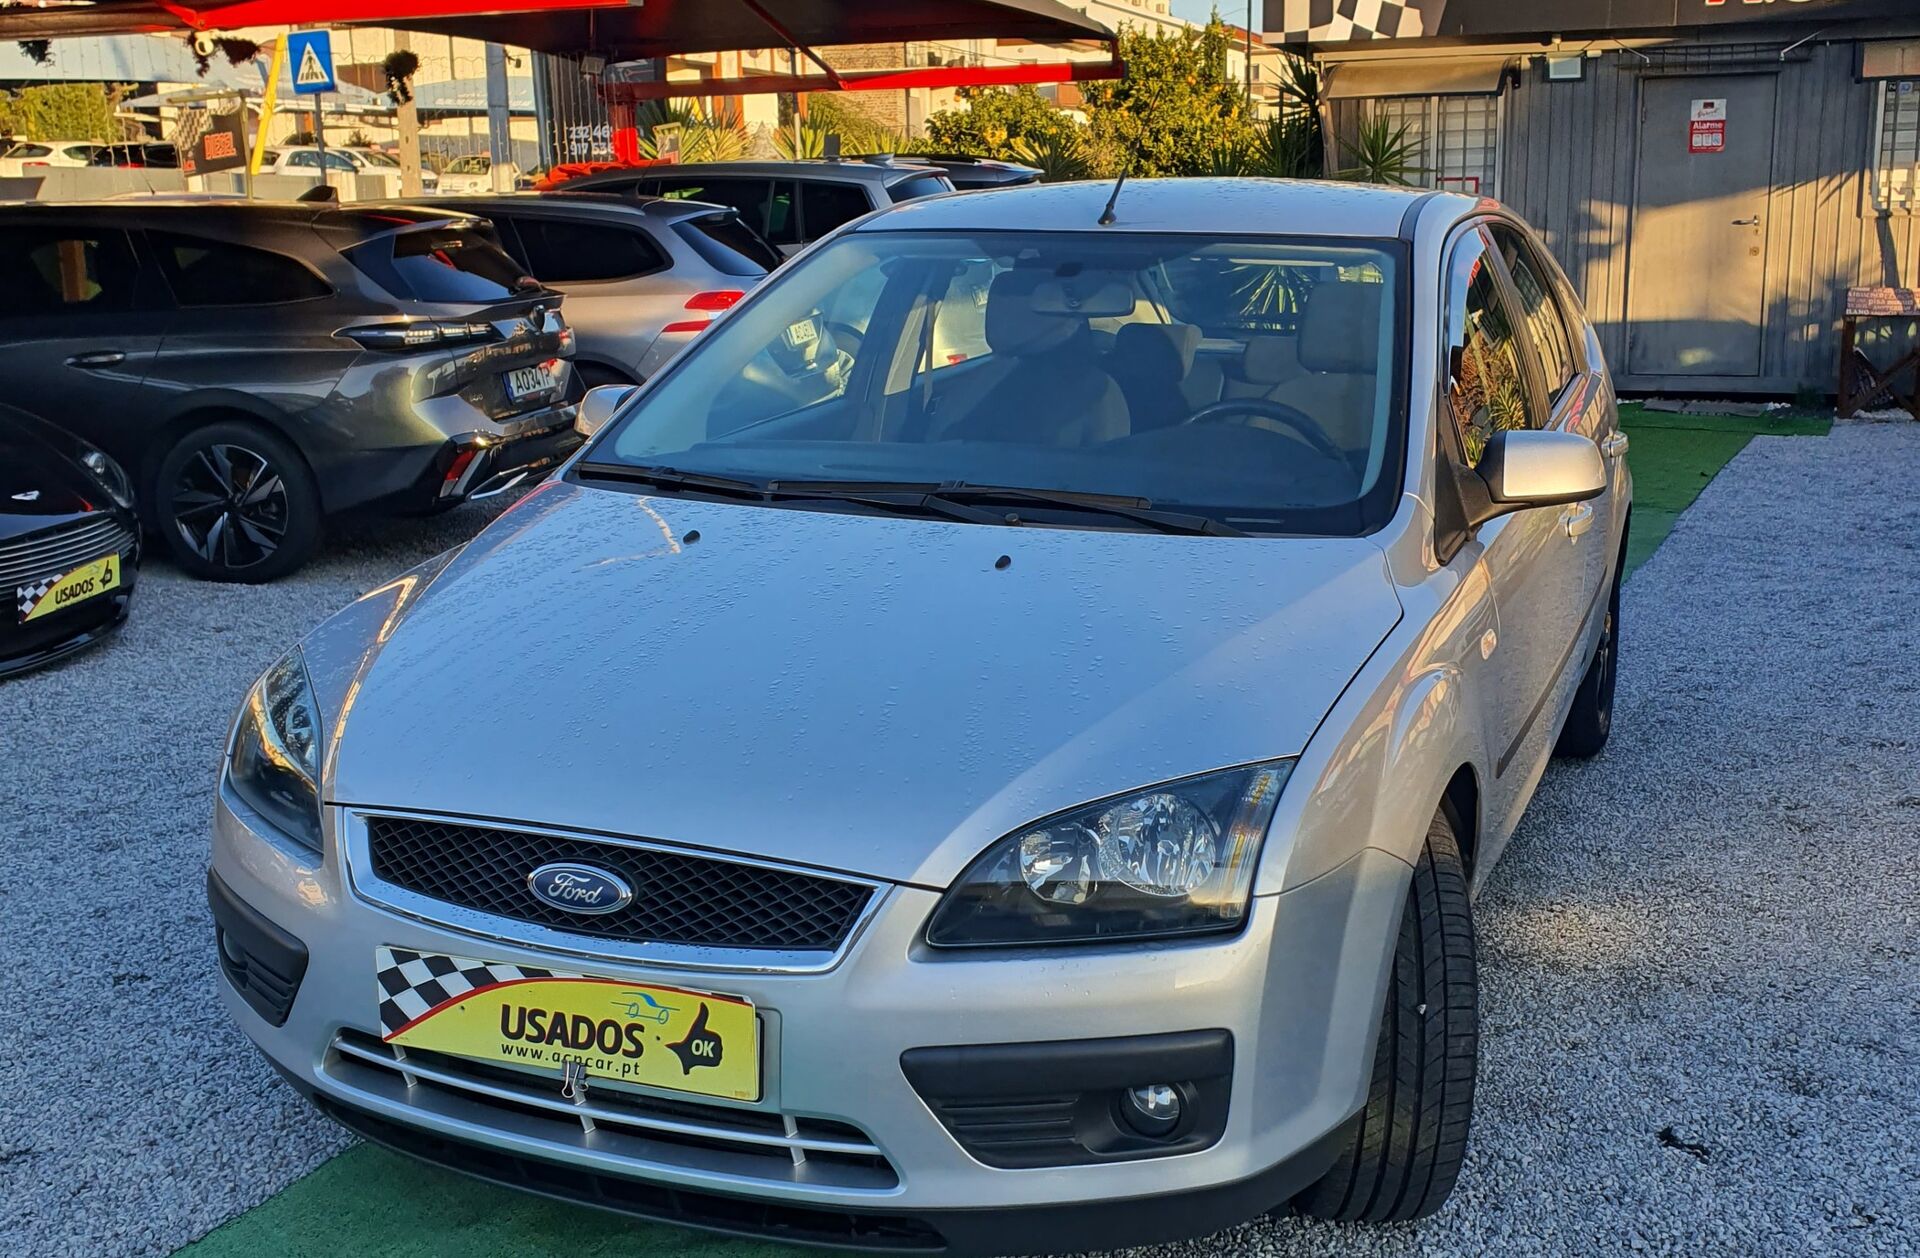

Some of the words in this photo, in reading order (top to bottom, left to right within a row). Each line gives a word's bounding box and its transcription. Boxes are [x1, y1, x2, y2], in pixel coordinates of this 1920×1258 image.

[1693, 121, 1723, 129] Alarme
[55, 577, 95, 605] USADOS
[548, 872, 604, 904] Ford
[500, 1003, 645, 1059] USADOS
[691, 1039, 715, 1058] OK
